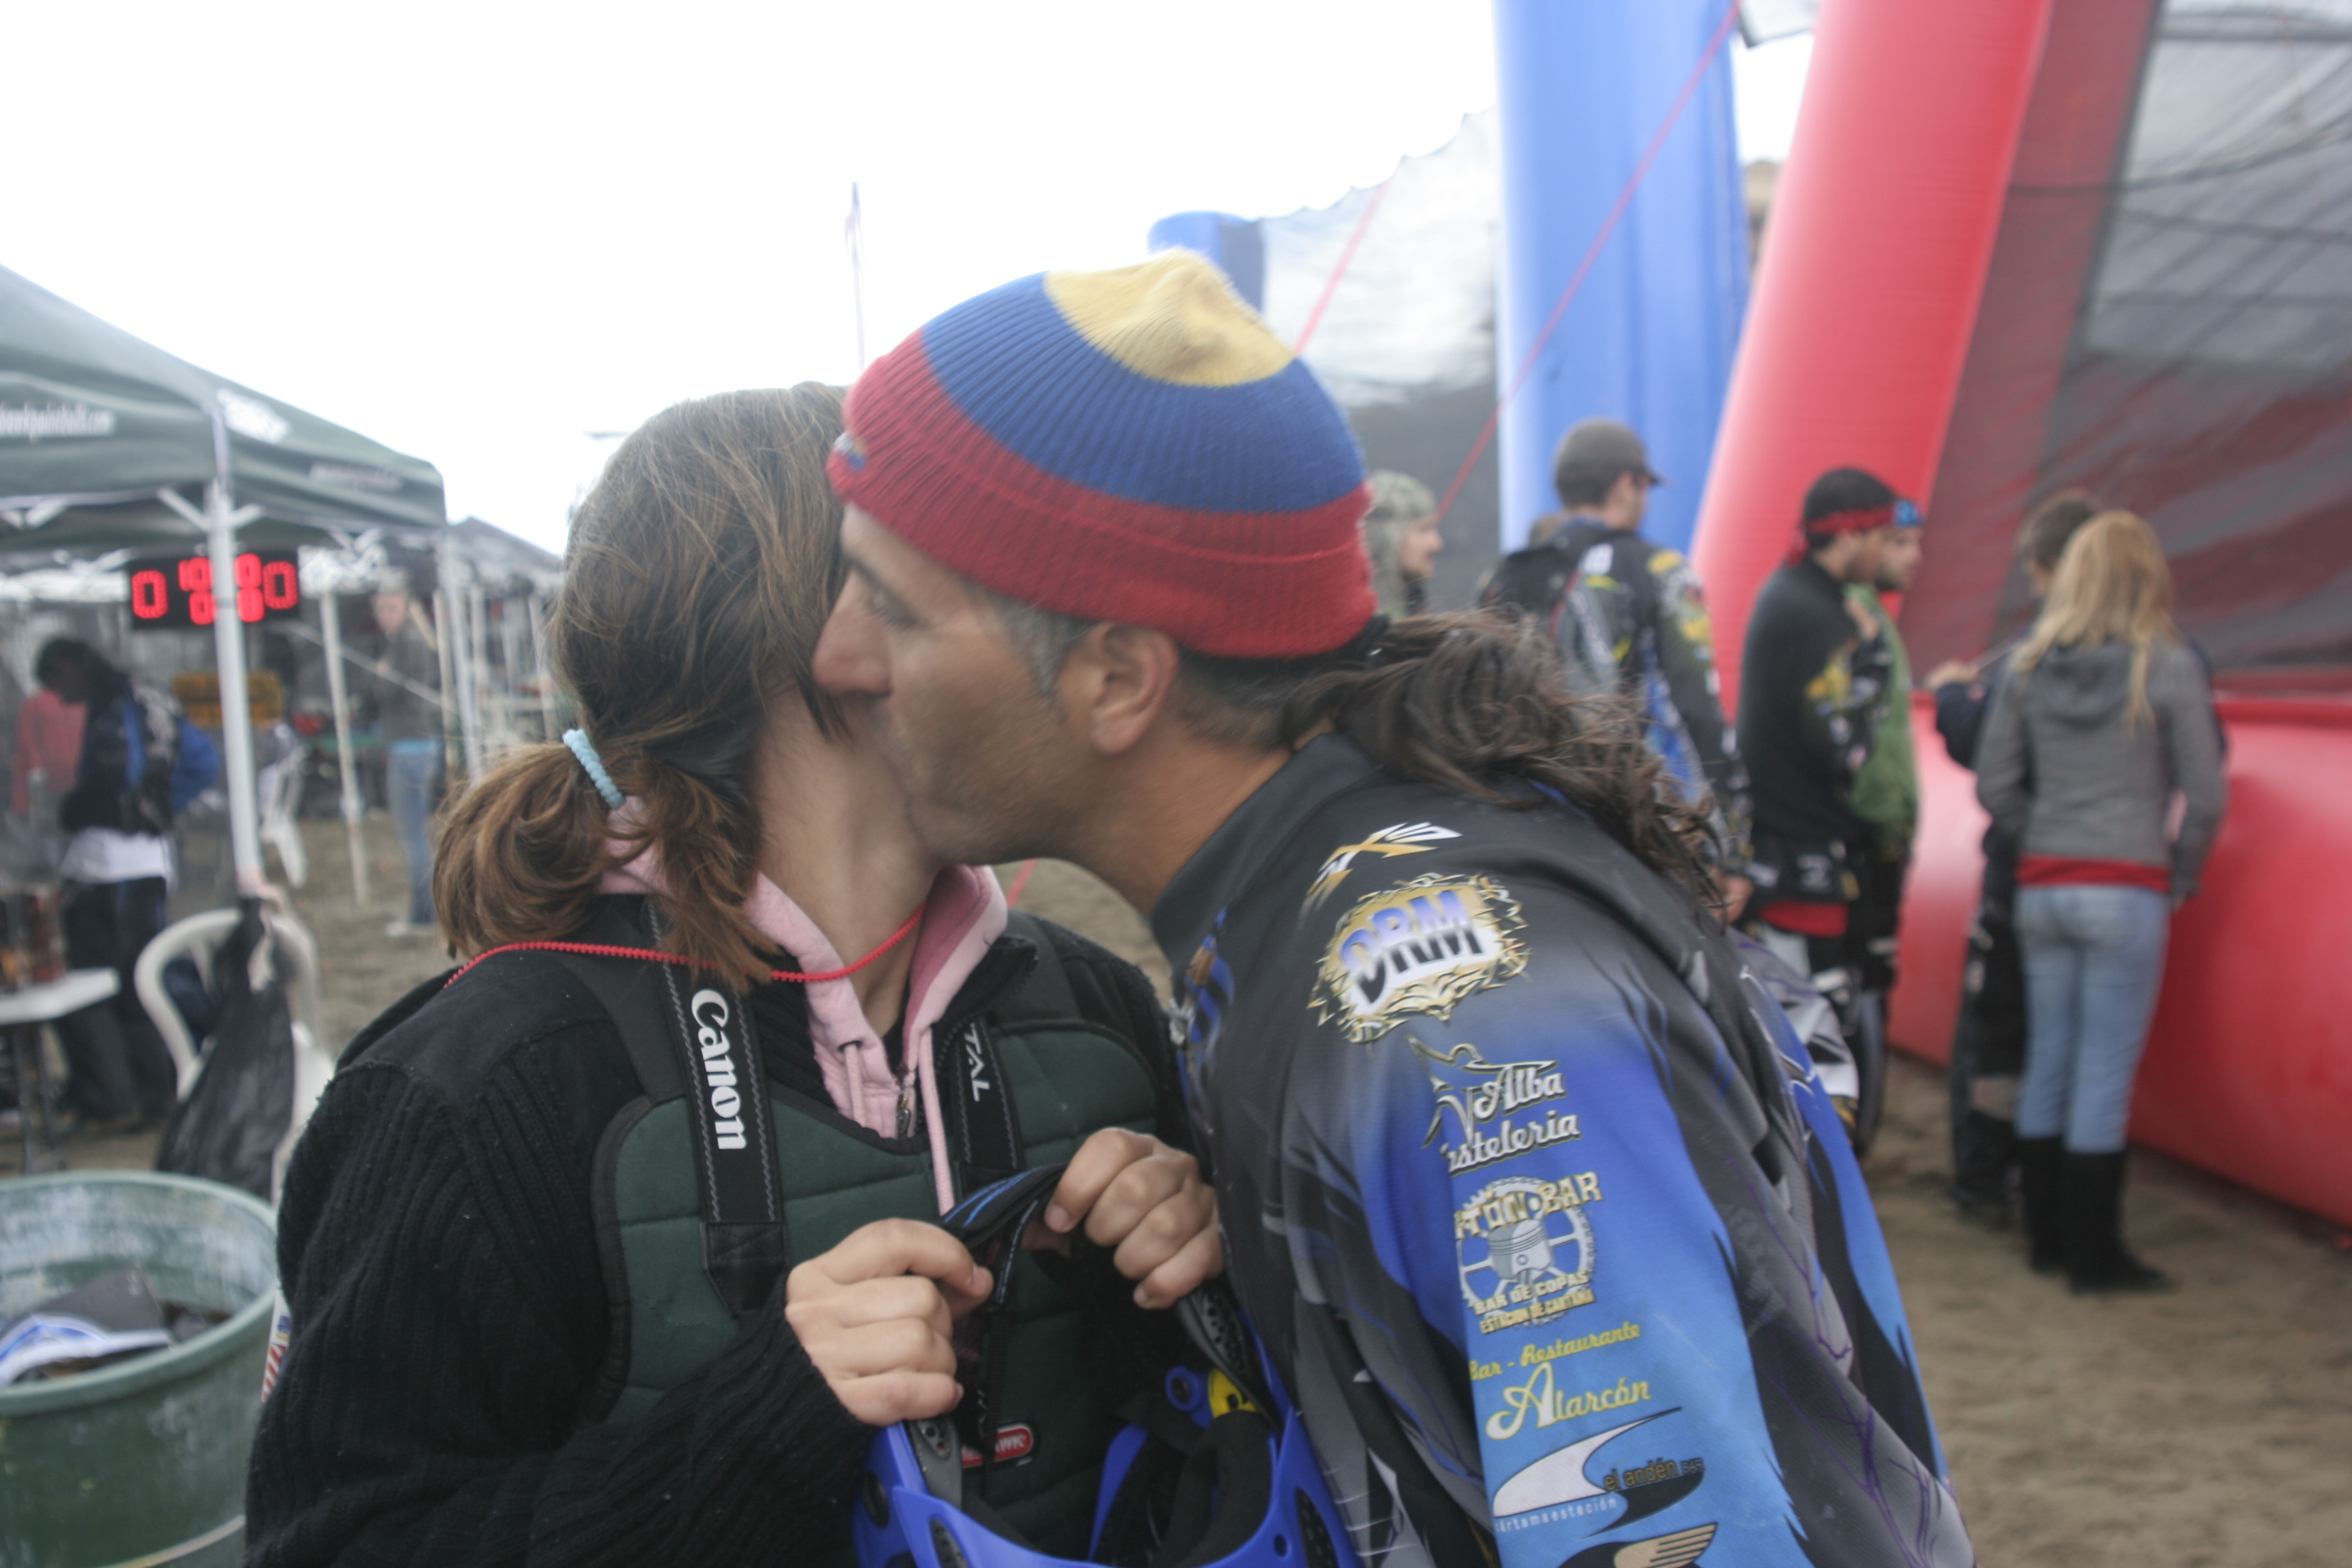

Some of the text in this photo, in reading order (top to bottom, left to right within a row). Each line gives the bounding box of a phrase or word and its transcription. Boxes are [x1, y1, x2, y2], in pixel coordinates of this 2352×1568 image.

[690, 988, 747, 1150] Canon
[1472, 1064, 1567, 1123] Alba
[1520, 1321, 1642, 1367] Restaurante
[1485, 1361, 1652, 1441] Alarcón
[1603, 1469, 1624, 1492] el
[1624, 1457, 1680, 1488] andén
